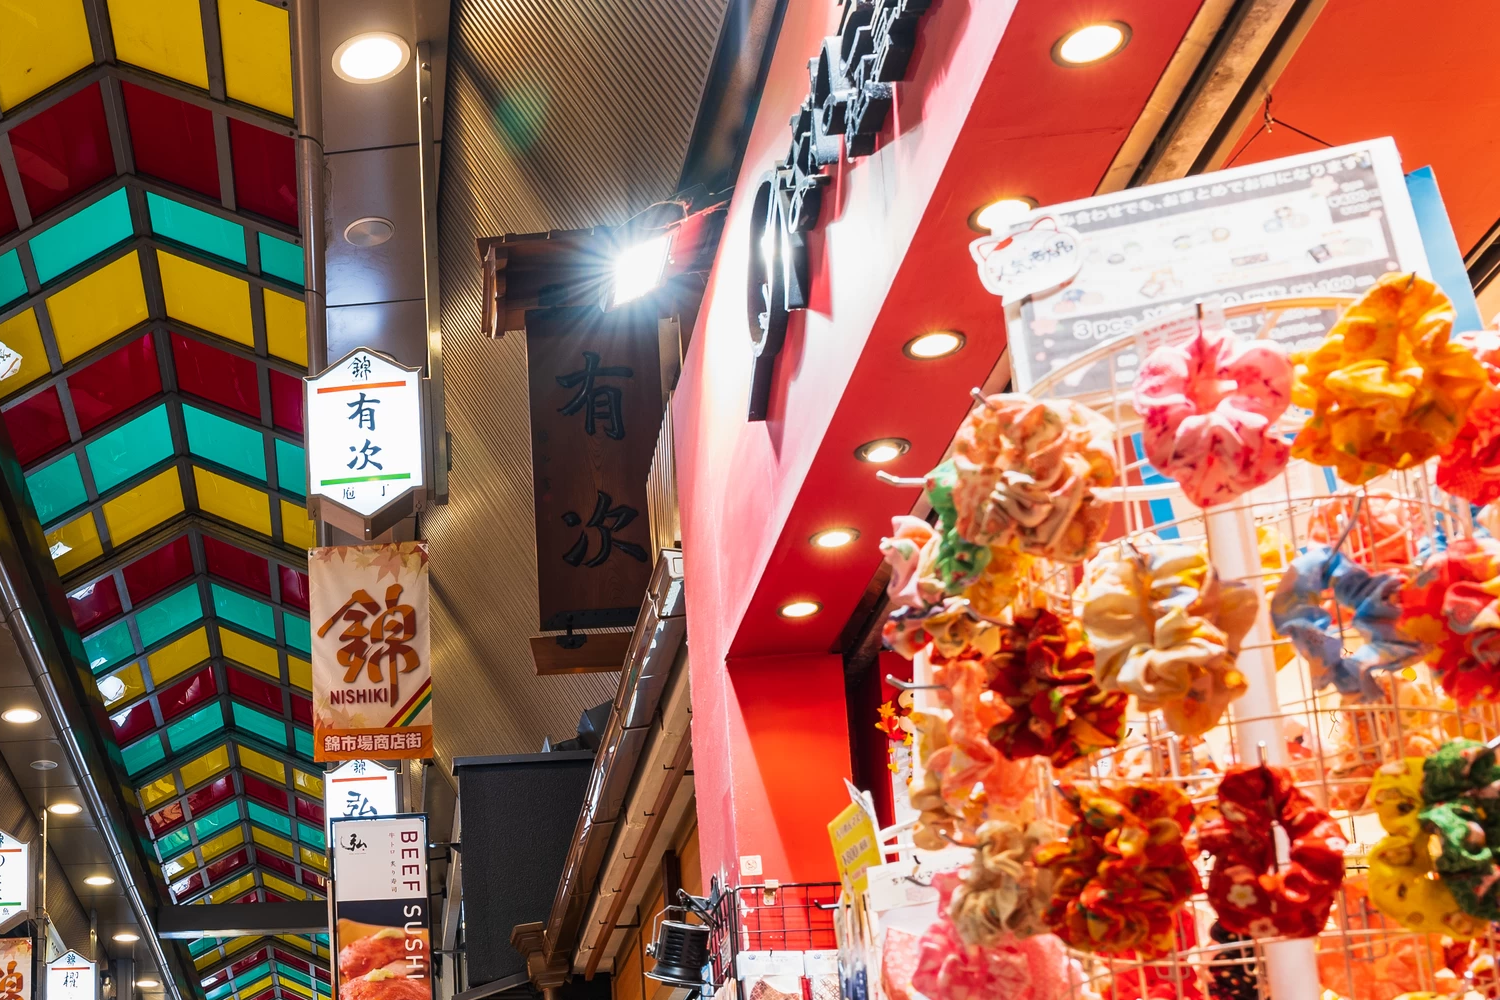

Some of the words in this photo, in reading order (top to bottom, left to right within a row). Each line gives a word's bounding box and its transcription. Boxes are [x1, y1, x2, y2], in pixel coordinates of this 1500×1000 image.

[347, 392, 383, 470] 有次
[555, 351, 648, 568] 有次
[317, 584, 420, 707] 錦
[330, 687, 388, 705] NISHIKI
[324, 731, 422, 753] 錦市場商店街
[400, 831, 420, 892] BEEF
[403, 904, 425, 980] SUSHI
